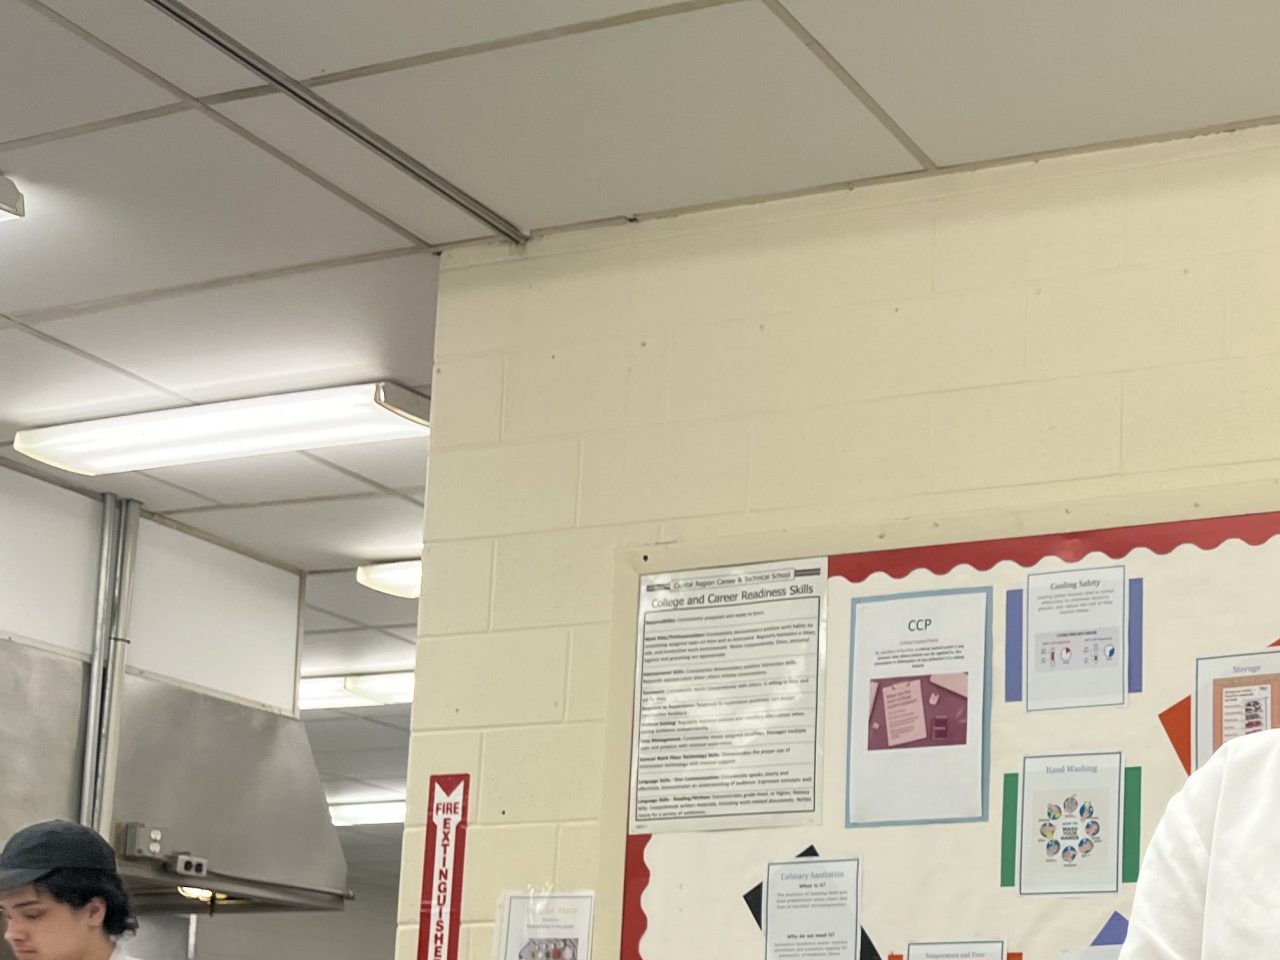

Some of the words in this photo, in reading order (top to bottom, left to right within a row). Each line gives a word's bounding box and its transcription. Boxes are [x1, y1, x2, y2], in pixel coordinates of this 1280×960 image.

[695, 579, 716, 589] Region
[716, 578, 736, 587] Career
[771, 571, 791, 581] School
[1079, 578, 1101, 588] Safety
[651, 597, 684, 610] College
[687, 594, 705, 606] and
[708, 591, 738, 604] Career
[741, 586, 787, 601] Readiness
[789, 583, 814, 596] Skills
[908, 618, 932, 632] CCP
[1232, 665, 1261, 674] Storage
[1046, 765, 1065, 774] Hand
[1067, 764, 1098, 774] Washing
[435, 801, 460, 815] FIRE
